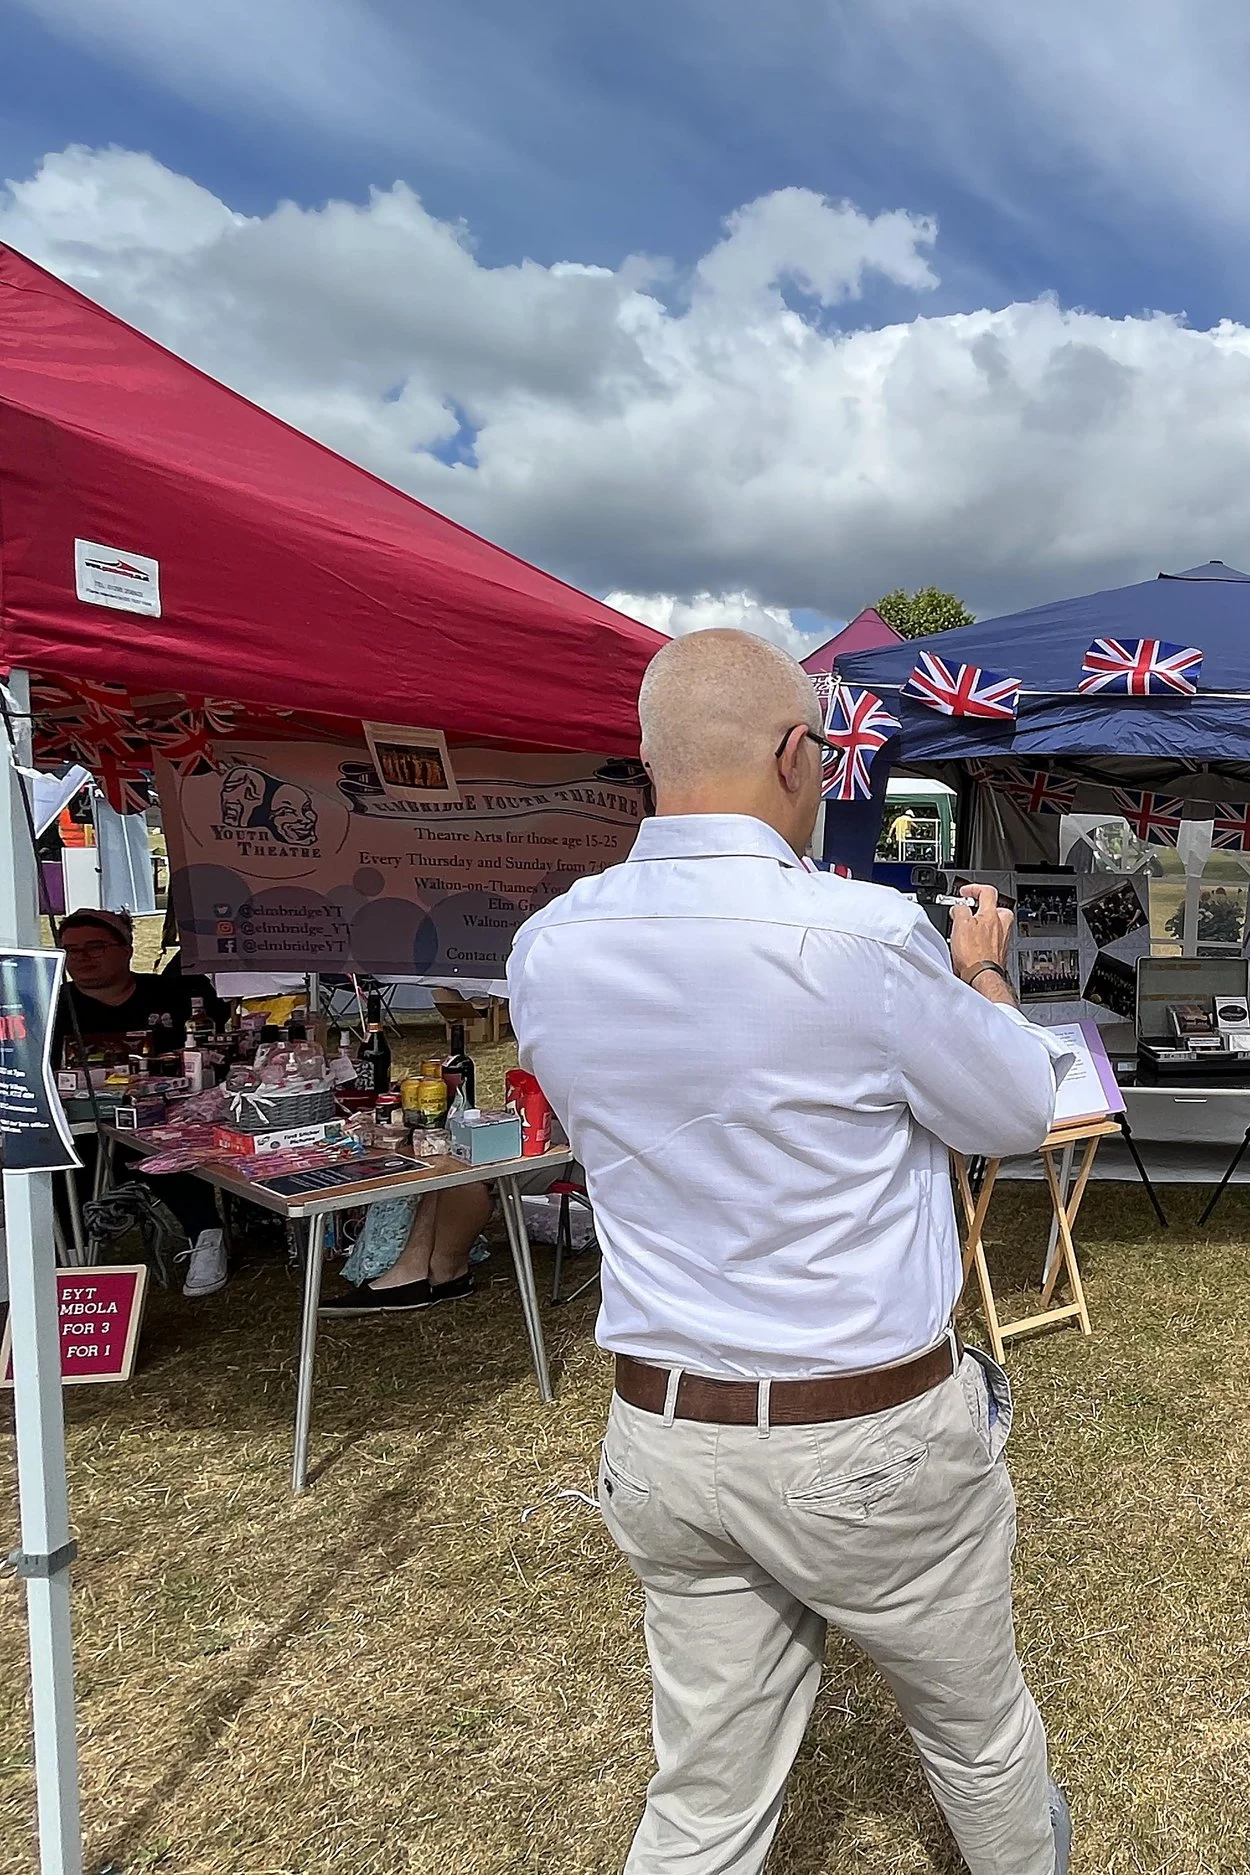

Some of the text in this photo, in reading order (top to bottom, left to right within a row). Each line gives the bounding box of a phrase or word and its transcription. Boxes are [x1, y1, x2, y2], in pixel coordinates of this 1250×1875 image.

[482, 794, 551, 810] YOUTH
[554, 788, 638, 817] THEATRE
[413, 827, 618, 849] Theatre Arts for those age 15-25
[359, 851, 402, 868] Every
[406, 852, 473, 870] Thursday
[477, 857, 501, 869] and
[505, 857, 552, 874] Sunday
[556, 859, 585, 872] from
[414, 877, 538, 893] Walton-on-Thames
[488, 897, 514, 911] Elm
[239, 904, 343, 919] @elmbridgeYT
[242, 939, 346, 954] @elmbridgeYT
[446, 947, 497, 961] Contact
[62, 1288, 97, 1300] EYT
[59, 1302, 118, 1315] MBOLA
[62, 1322, 110, 1336] FOR 3
[66, 1345, 111, 1358] FOR 1
